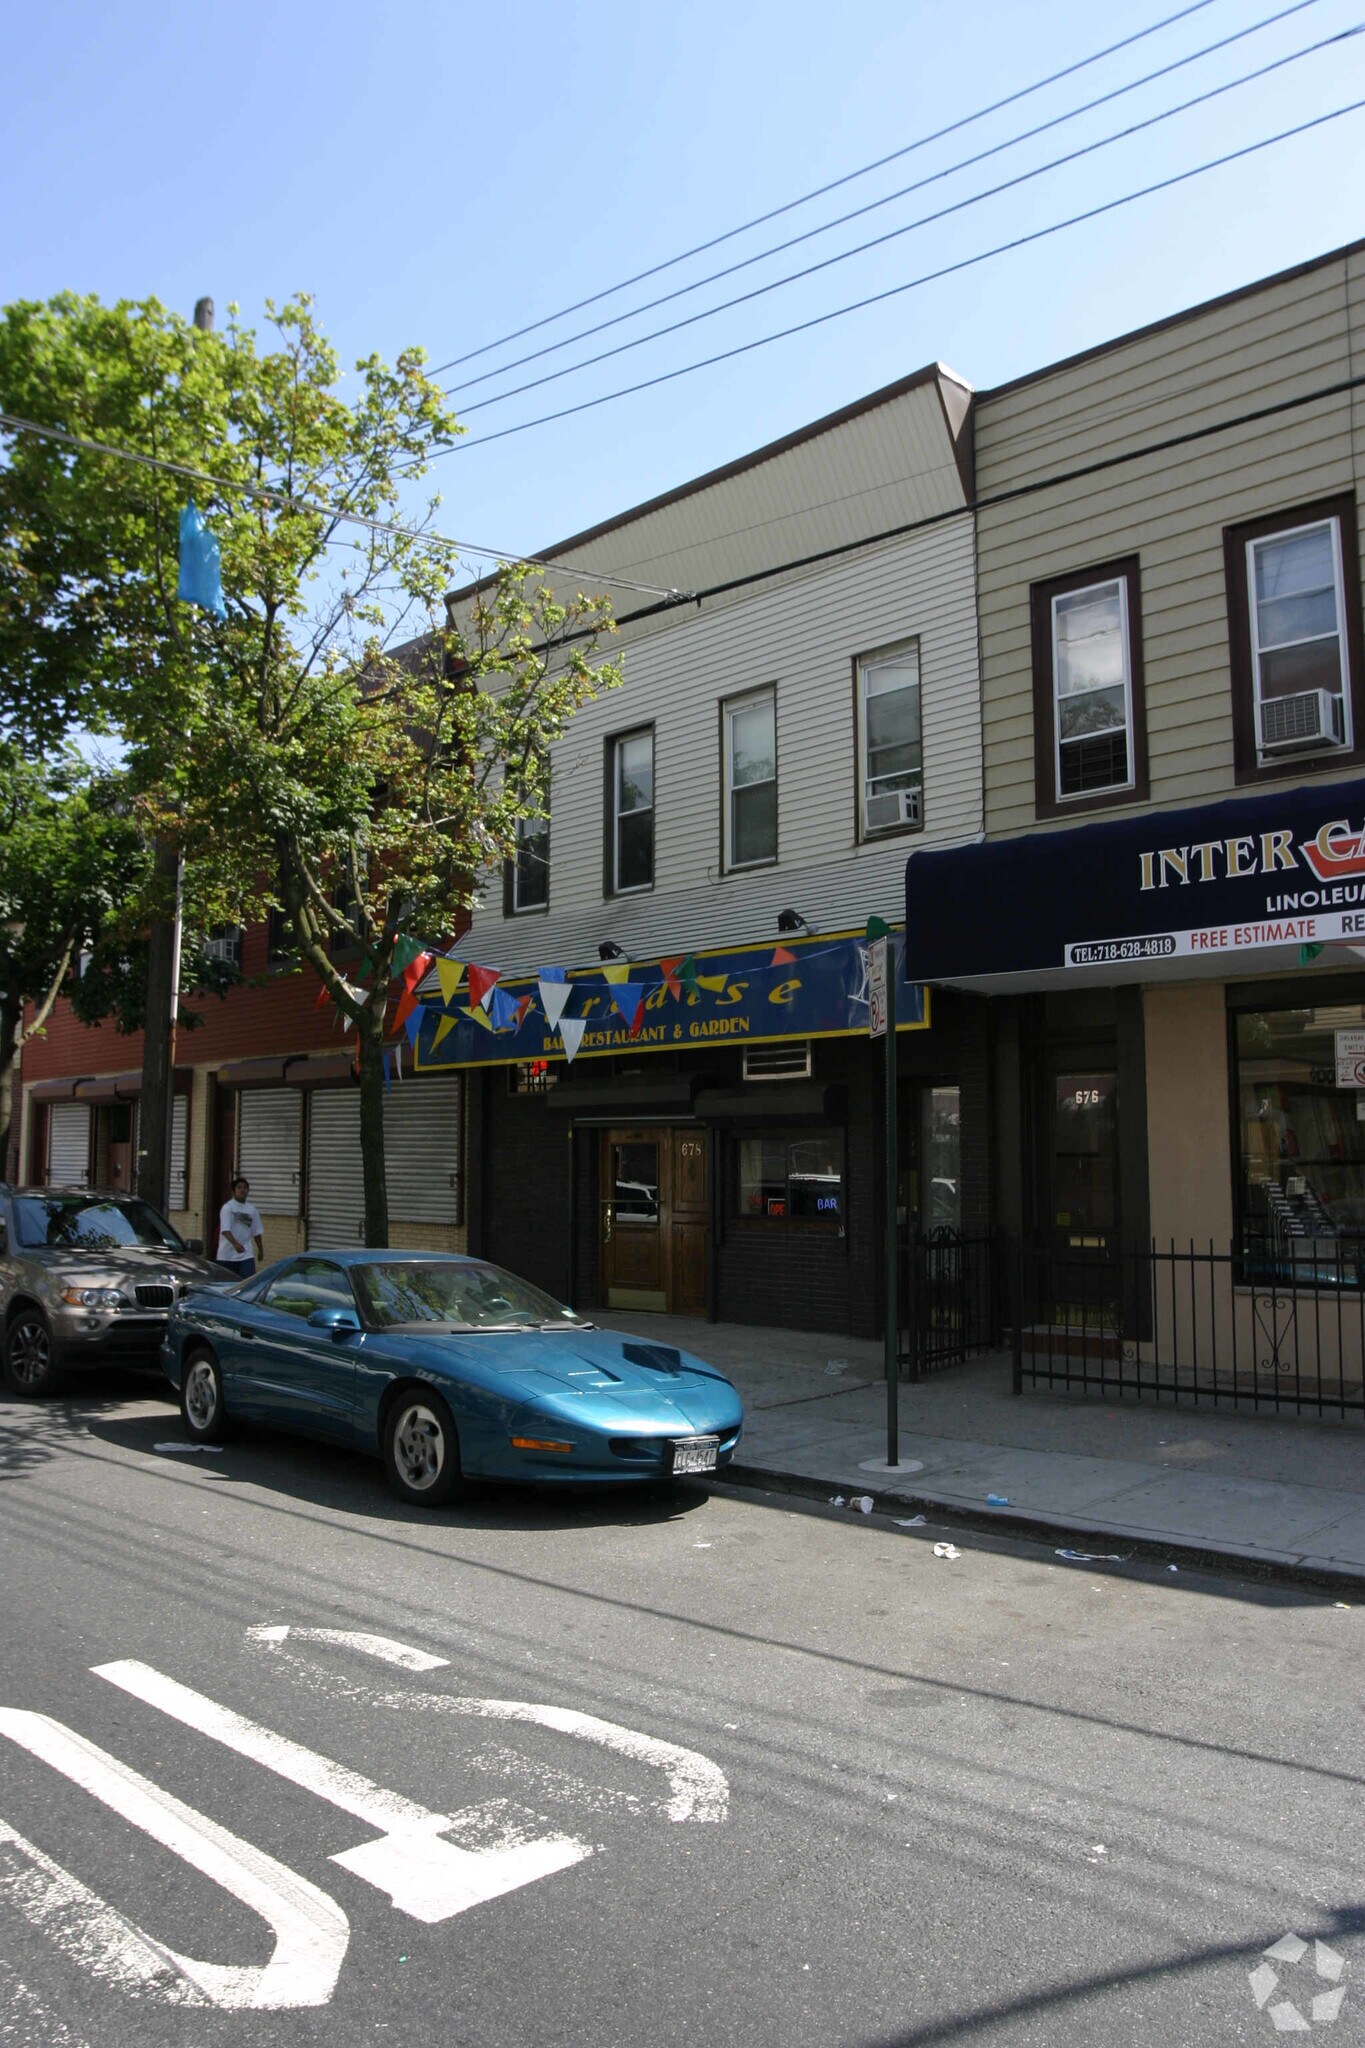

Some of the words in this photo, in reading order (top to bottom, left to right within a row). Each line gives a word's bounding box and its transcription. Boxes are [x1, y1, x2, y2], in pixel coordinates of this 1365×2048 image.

[1139, 829, 1299, 891] INTER
[1315, 817, 1365, 862] C
[1191, 929, 1228, 949] FREE
[1234, 919, 1316, 945] ESTIMATE
[1073, 938, 1172, 962] TEL:718-628-4818
[487, 978, 803, 1036] rdise
[581, 1025, 667, 1048] RESTAUANT
[673, 1024, 683, 1039] &
[689, 1016, 750, 1038] GARDEN
[1075, 1089, 1099, 1105] 676
[682, 1142, 702, 1157] 678
[769, 1203, 785, 1216] OPE
[816, 1198, 838, 1211] BAR
